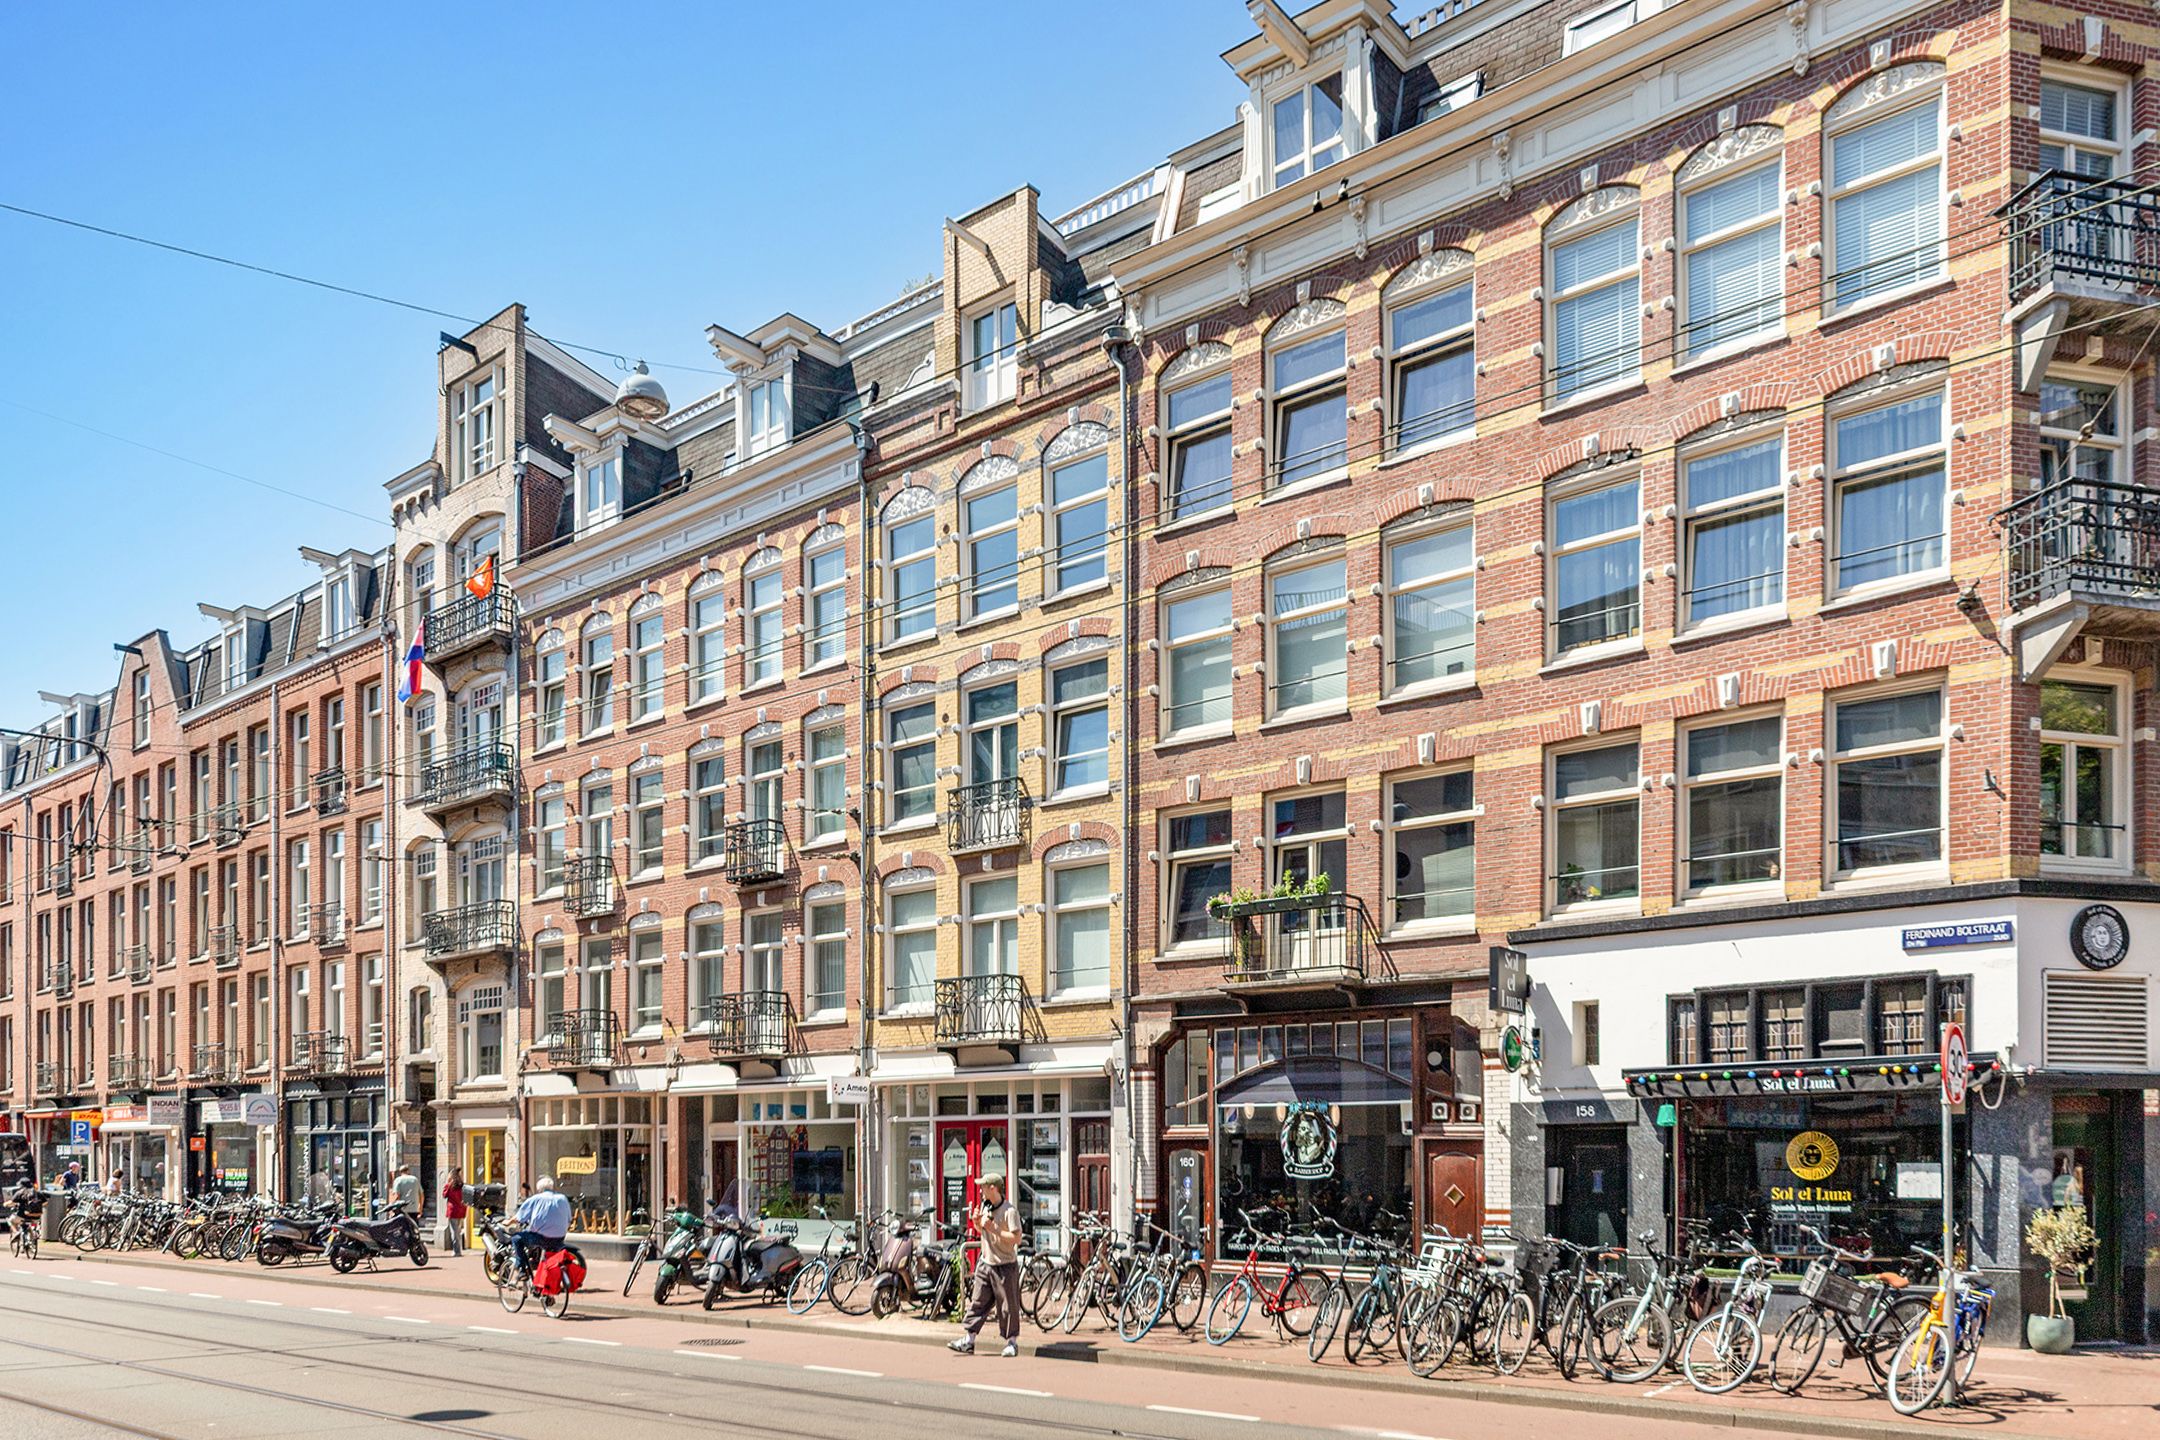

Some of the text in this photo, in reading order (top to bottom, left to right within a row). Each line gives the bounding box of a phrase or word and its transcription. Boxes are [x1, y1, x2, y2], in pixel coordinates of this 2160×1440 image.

[1905, 923, 2007, 940] FERDINAND BOLSTRAAT
[1504, 952, 1519, 972] Sol
[1507, 974, 1516, 991] el
[1501, 989, 1523, 1012] Luna
[1950, 1049, 1963, 1078] 30
[846, 1083, 868, 1092] Ameo
[1762, 1075, 1836, 1091] Sol el Luna
[1576, 1105, 1595, 1117] 158
[75, 1122, 86, 1136] P
[1180, 1157, 1195, 1167] 160
[1771, 1187, 1852, 1202] Sol el Luna
[1771, 1204, 1852, 1213] Spanish Tapas Restaurant
